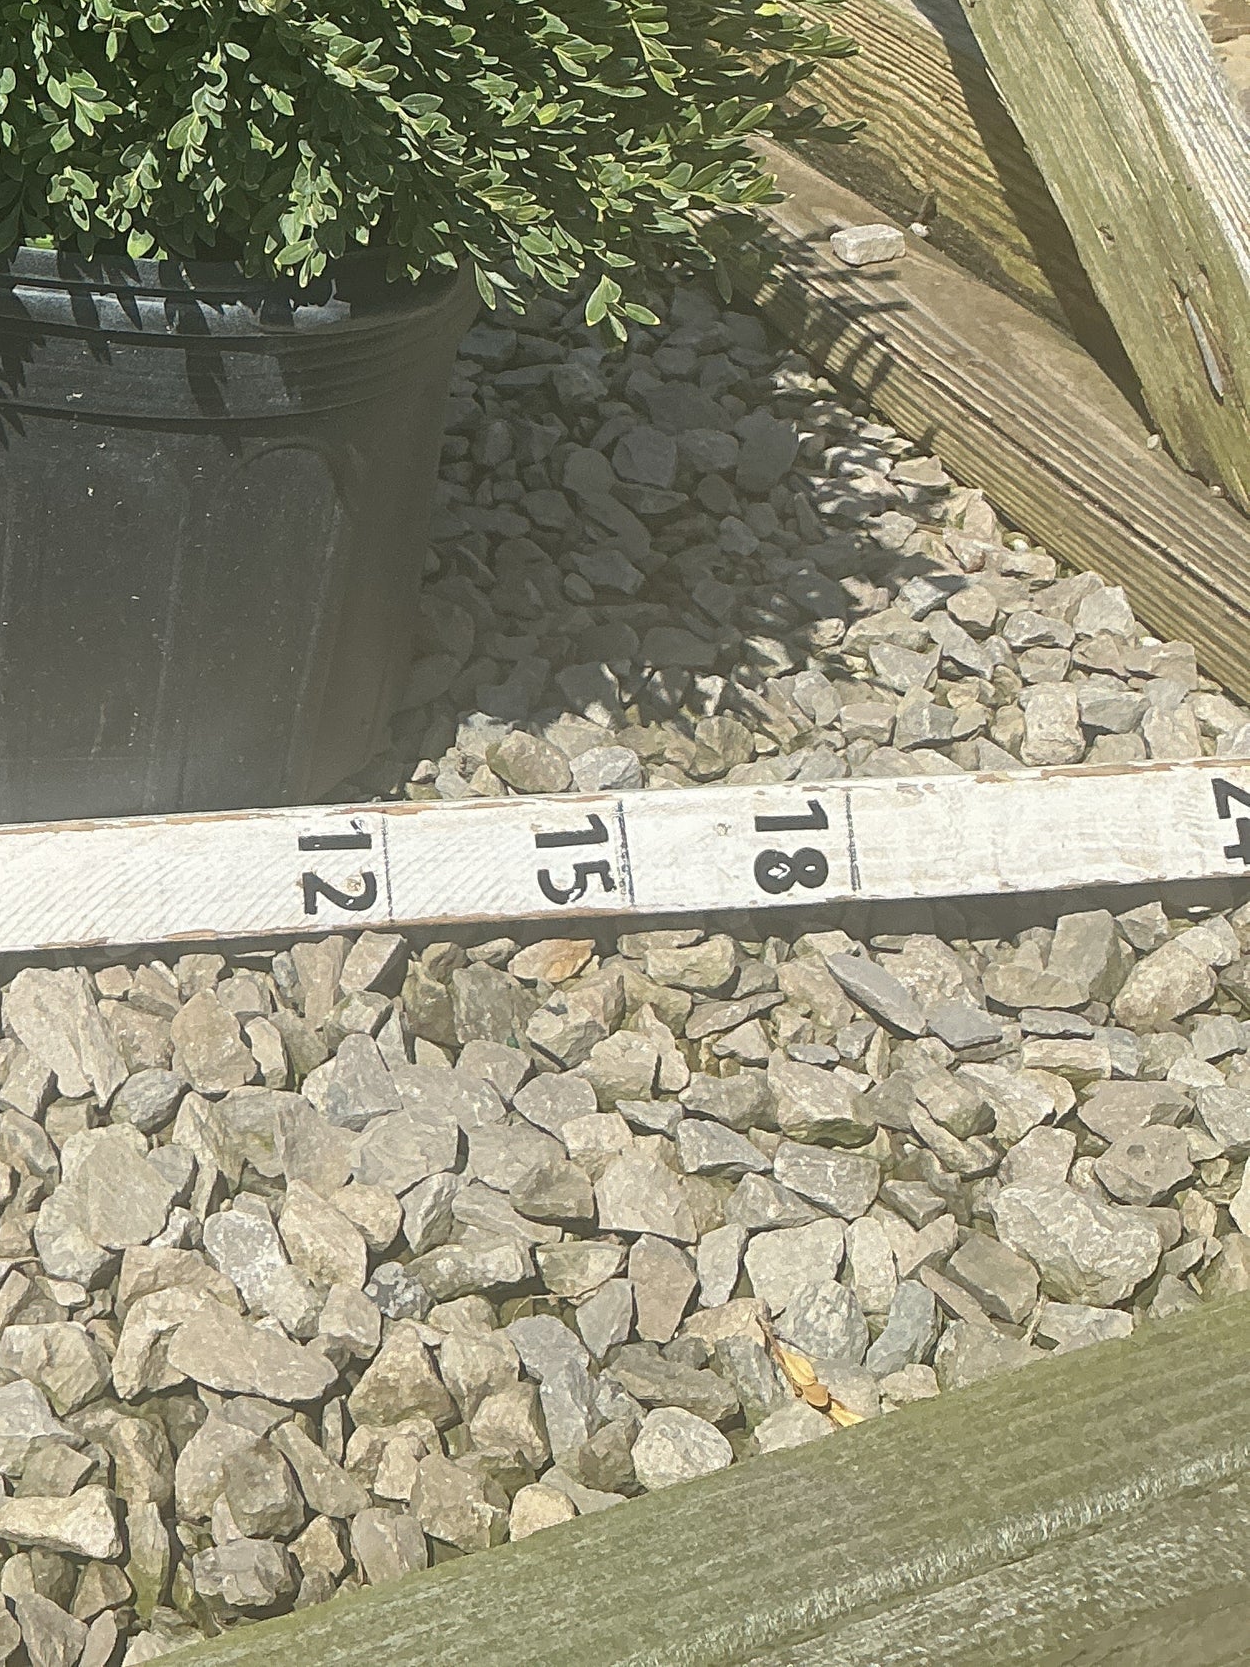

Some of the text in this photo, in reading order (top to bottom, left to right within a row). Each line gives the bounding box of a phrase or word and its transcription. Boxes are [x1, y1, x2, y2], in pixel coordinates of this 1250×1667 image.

[298, 817, 378, 915] 12
[535, 814, 617, 905] 15
[754, 800, 829, 895] 18
